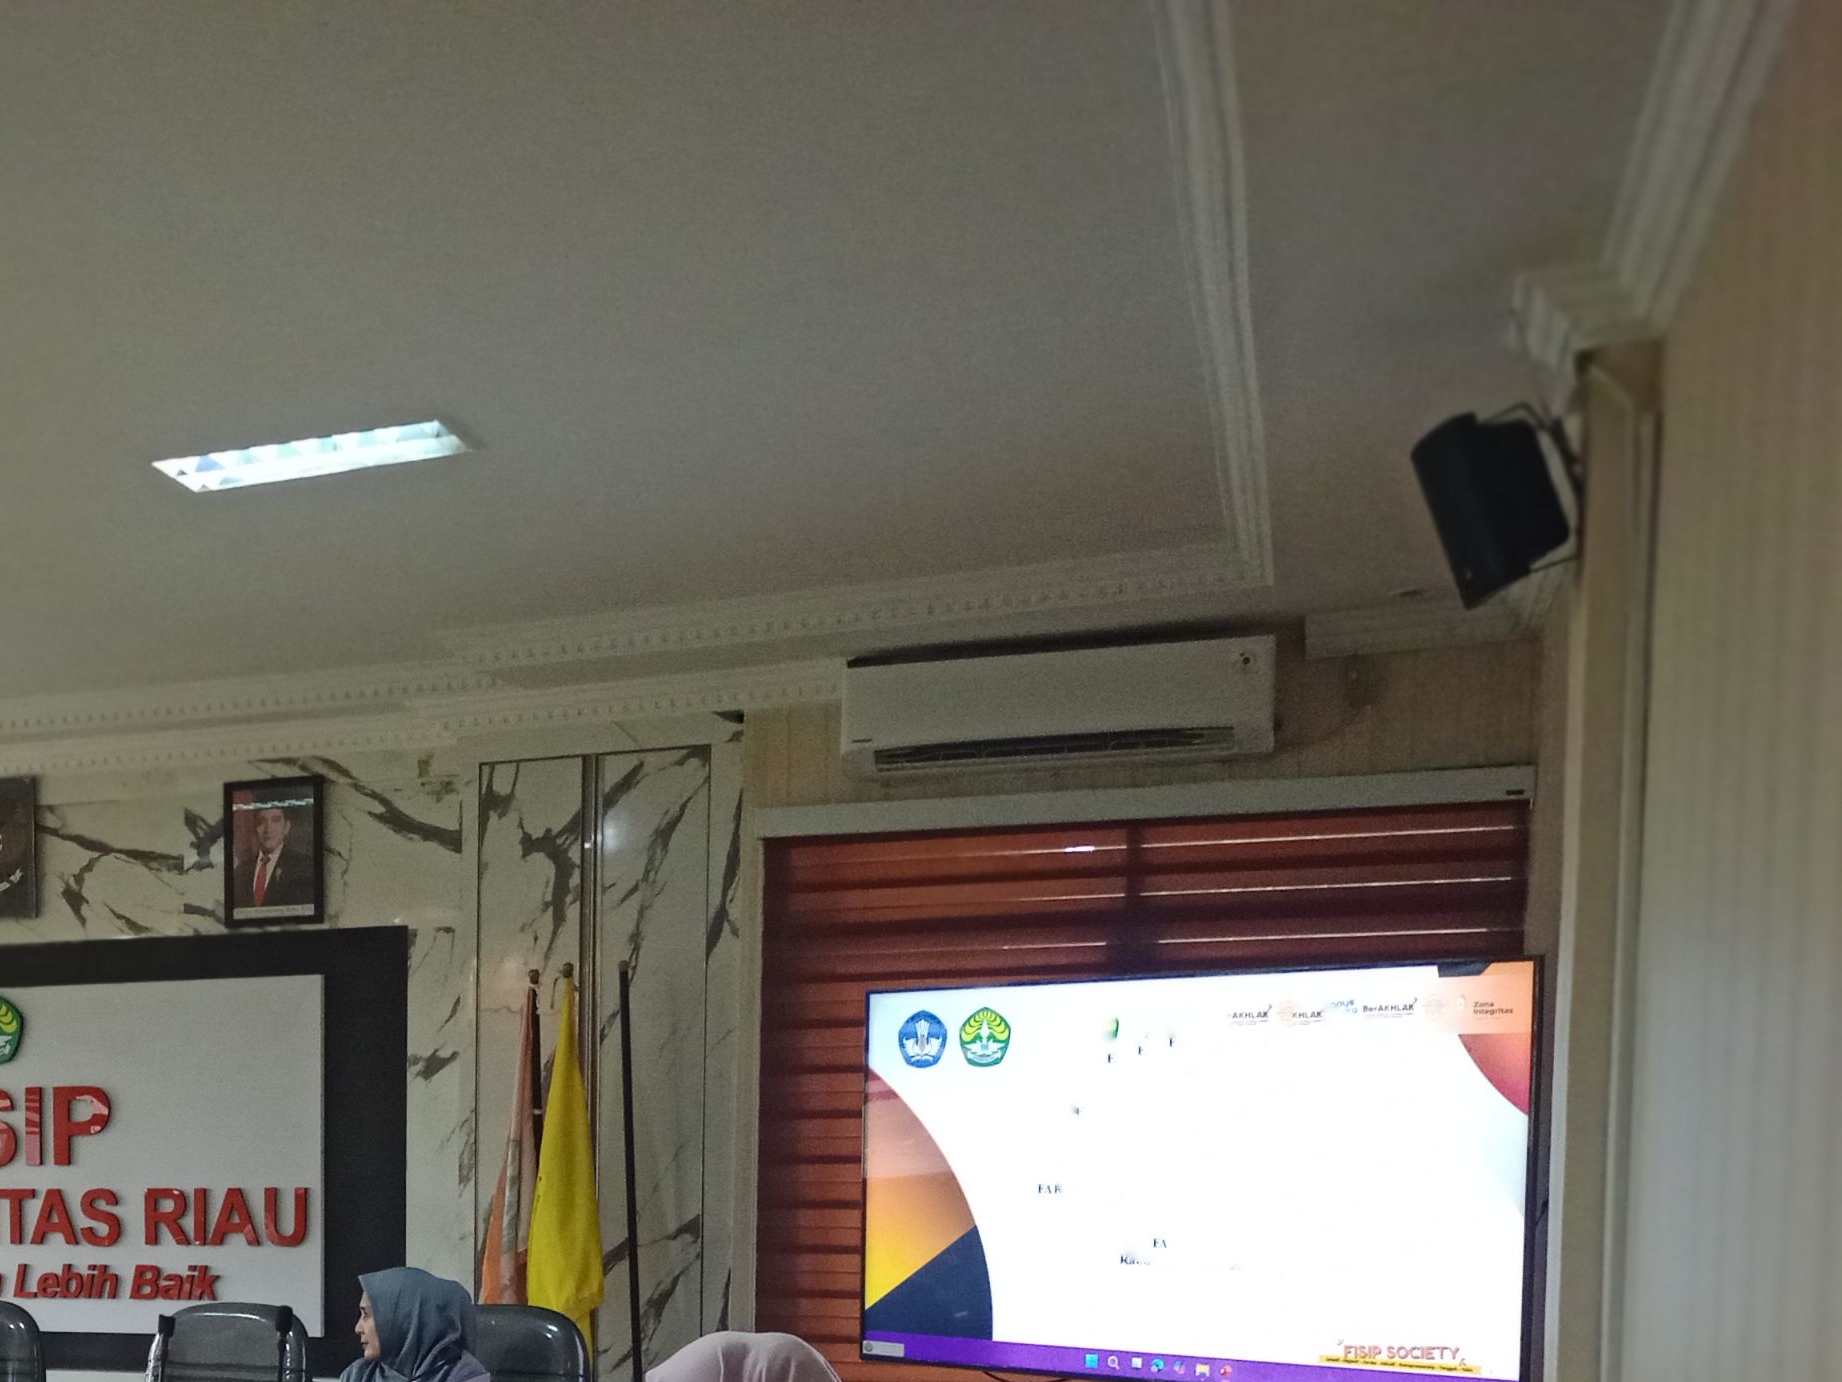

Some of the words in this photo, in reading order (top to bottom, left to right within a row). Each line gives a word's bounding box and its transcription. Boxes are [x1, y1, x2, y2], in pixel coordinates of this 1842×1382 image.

[144, 1186, 312, 1248] RIAU
[13, 1263, 119, 1299] Lebih
[129, 1264, 220, 1301] Baik
[1344, 1344, 1382, 1359] FISIP
[1386, 1345, 1460, 1361] SOCIETY
